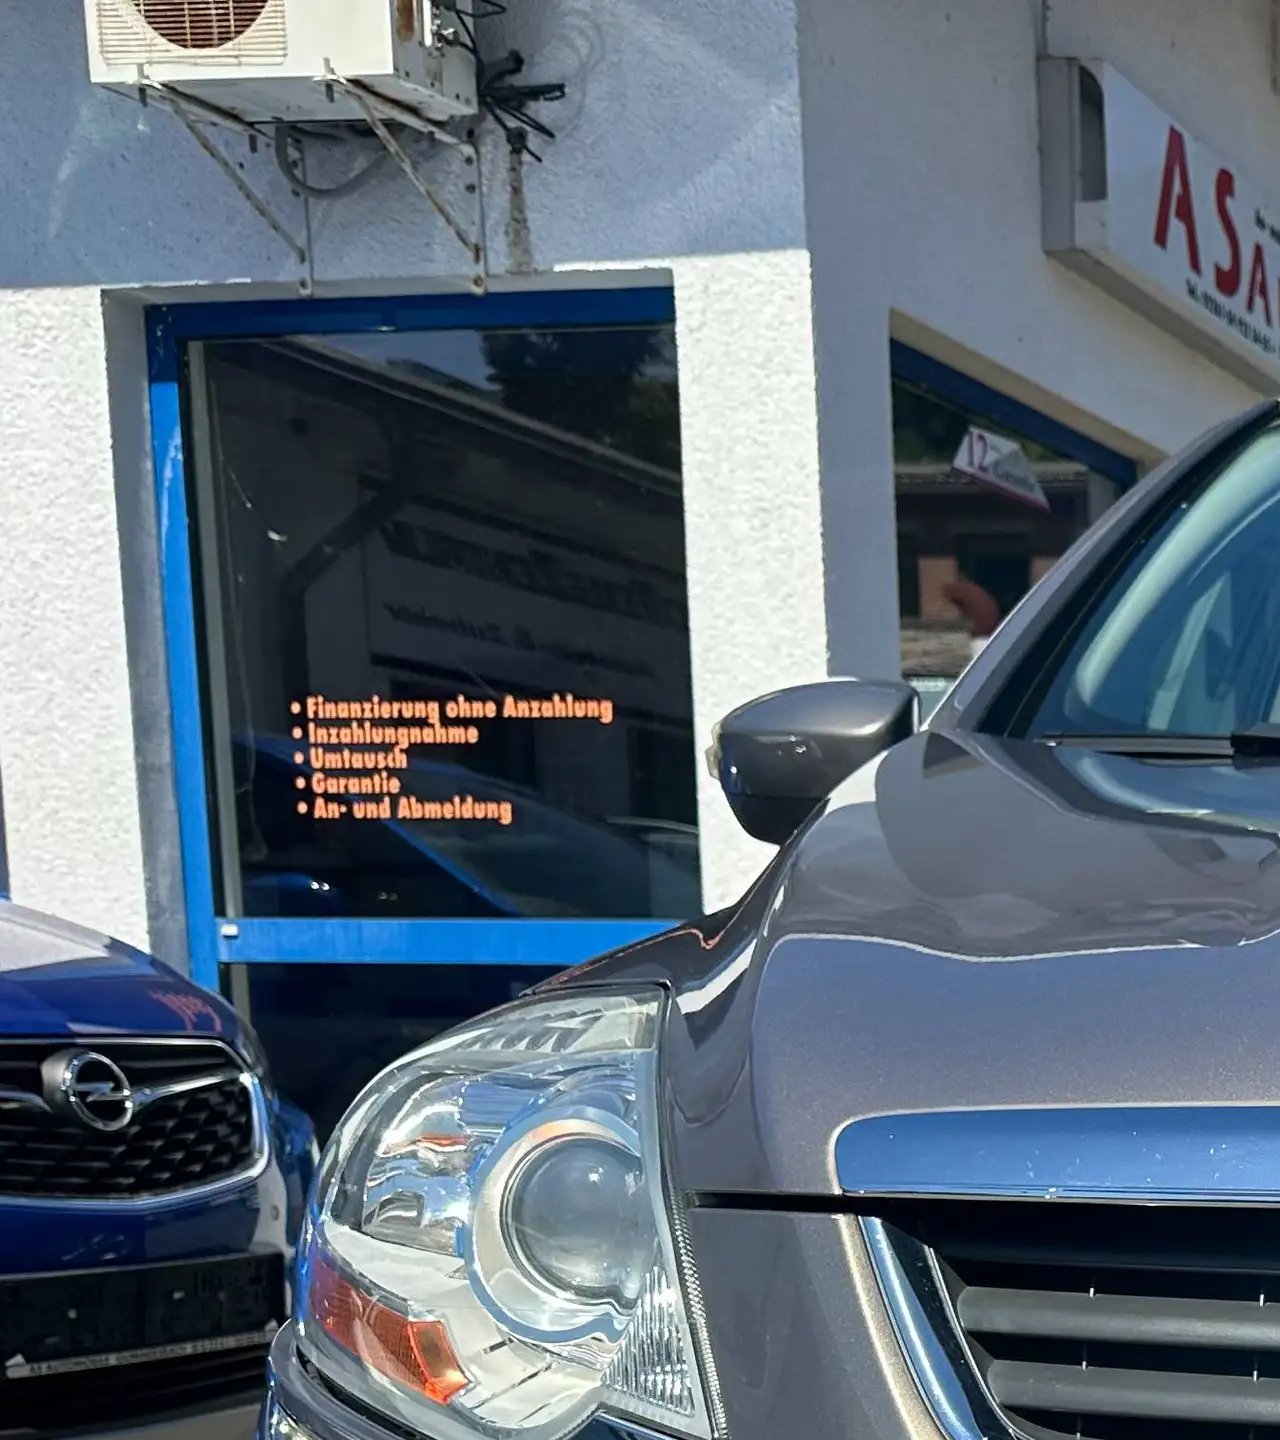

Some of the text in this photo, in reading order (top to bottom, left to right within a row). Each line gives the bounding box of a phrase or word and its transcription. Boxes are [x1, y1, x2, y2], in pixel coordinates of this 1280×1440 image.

[1153, 124, 1241, 298] AS
[306, 693, 614, 724] Finanzierung ohne Anzahlung
[308, 721, 480, 749] Inzahlungnahme
[309, 746, 408, 769] Umtausch
[311, 770, 401, 794] Garantie
[313, 795, 513, 825] An- und Abmeldung
